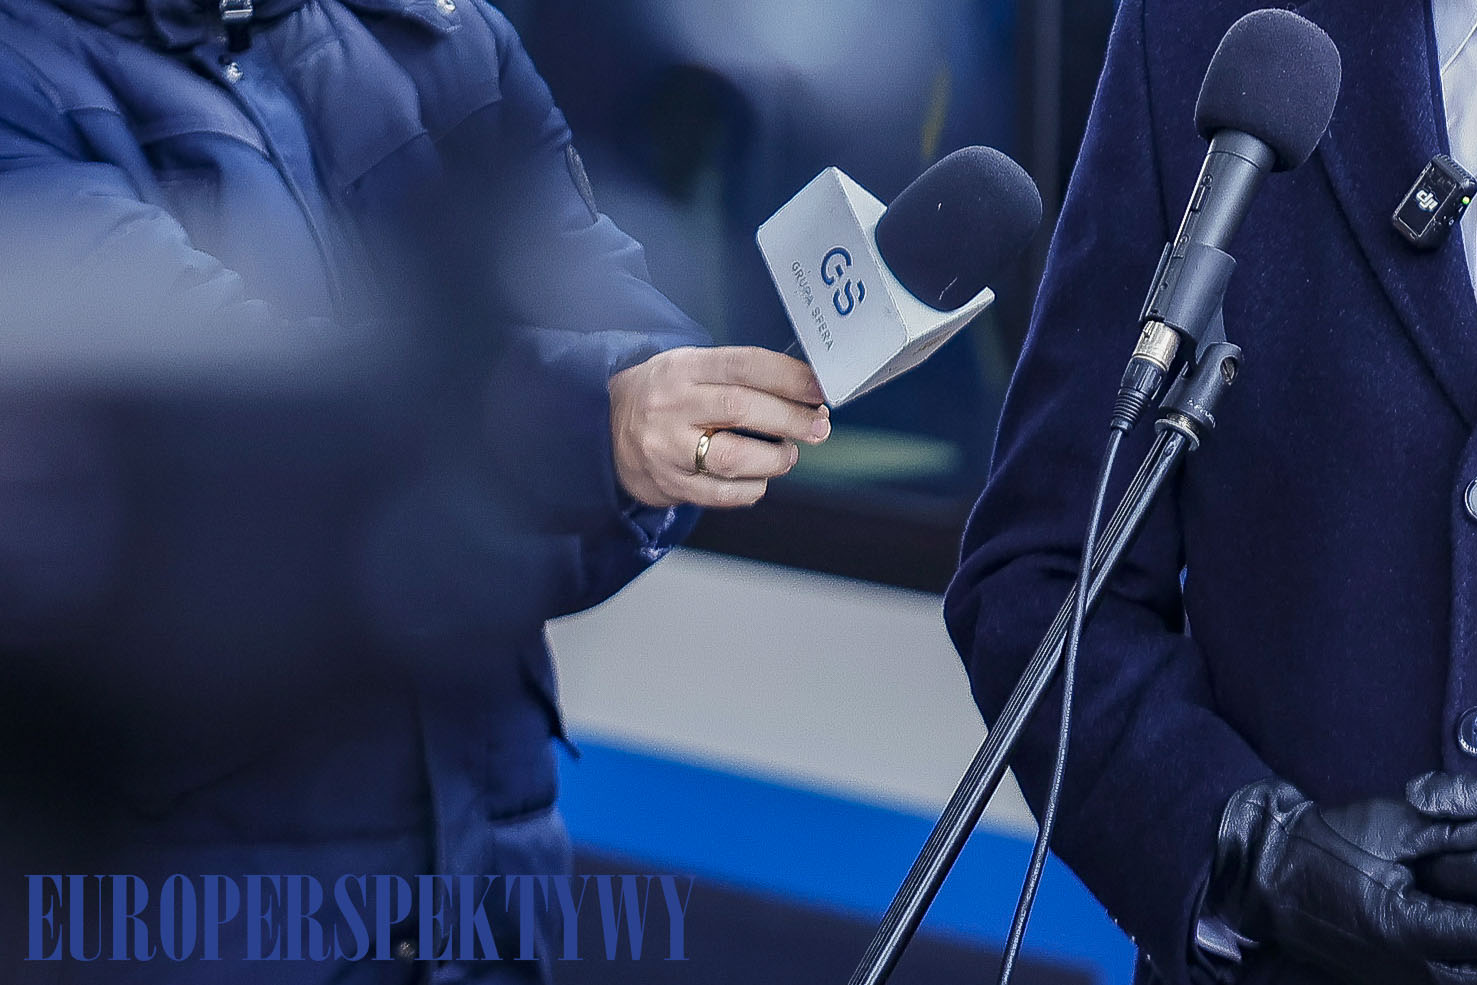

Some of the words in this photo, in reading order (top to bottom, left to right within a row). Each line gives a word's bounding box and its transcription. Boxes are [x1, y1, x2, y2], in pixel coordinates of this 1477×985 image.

[791, 260, 815, 307] GRUPA
[811, 306, 835, 352] SFERA
[821, 246, 866, 316] GS
